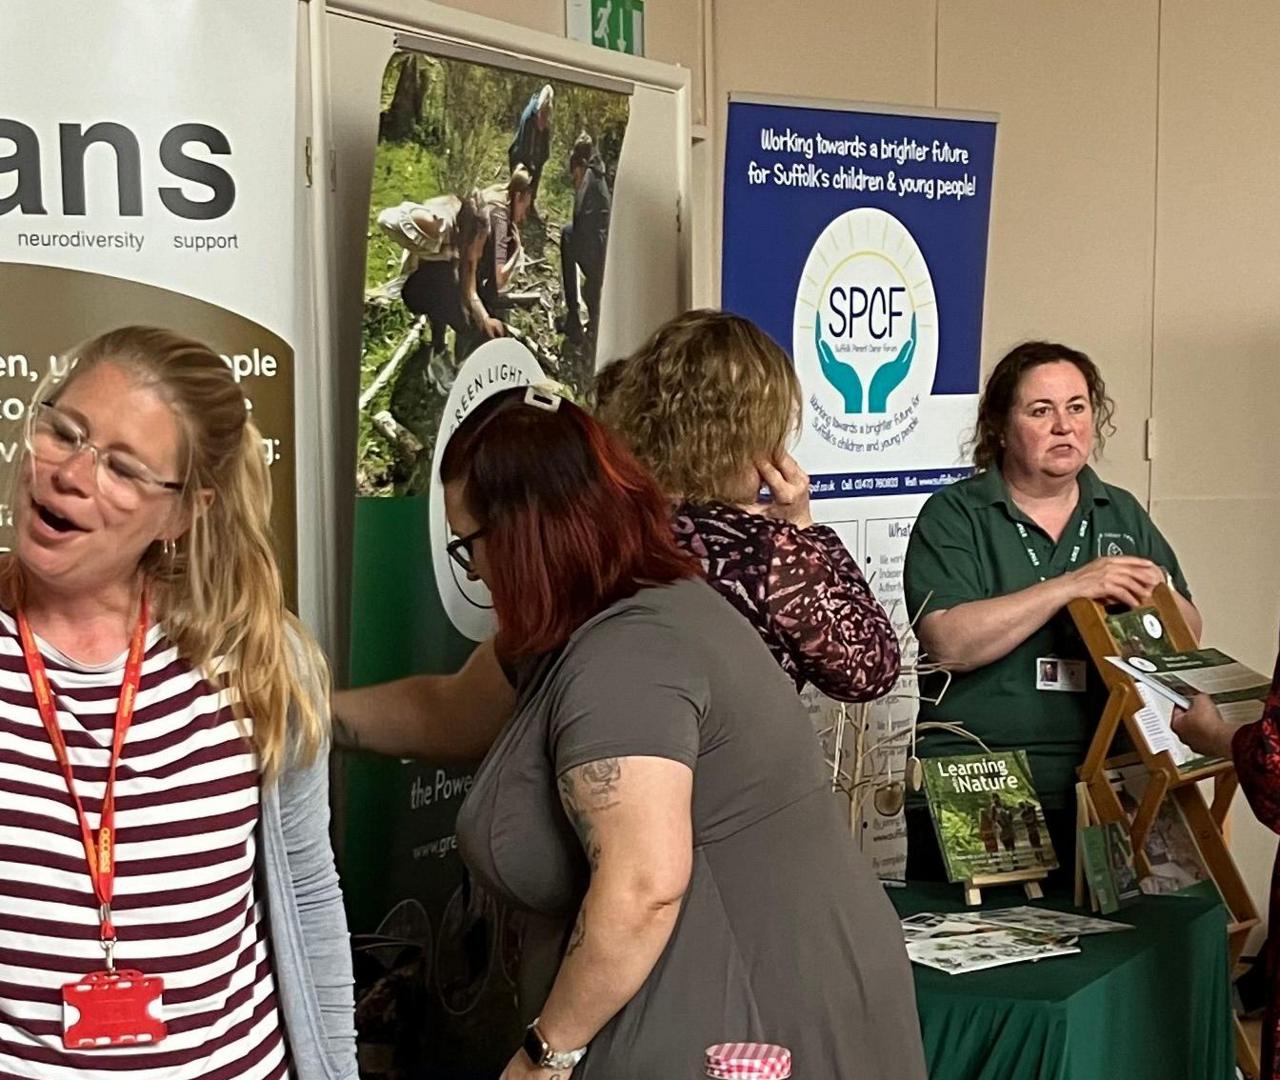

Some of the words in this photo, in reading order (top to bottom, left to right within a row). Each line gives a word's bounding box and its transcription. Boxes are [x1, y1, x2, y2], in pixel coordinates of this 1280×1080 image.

[761, 128, 813, 159] Working
[816, 133, 866, 158] towards
[870, 143, 878, 158] a
[881, 137, 929, 165] brighter
[932, 140, 968, 164] future
[748, 161, 770, 184] for
[774, 163, 829, 187] Suffolk's
[833, 166, 884, 191] children
[887, 171, 896, 191] &
[899, 178, 934, 199] young
[937, 173, 976, 200] people!
[18, 231, 144, 252] neurodiversity
[174, 234, 238, 251] support
[829, 286, 906, 339] SPCF
[451, 374, 483, 433] REEN
[488, 364, 522, 383] LIGHT
[888, 523, 911, 538] What
[938, 758, 1008, 776] Learning
[411, 776, 432, 809] the
[958, 775, 1018, 793] Nature
